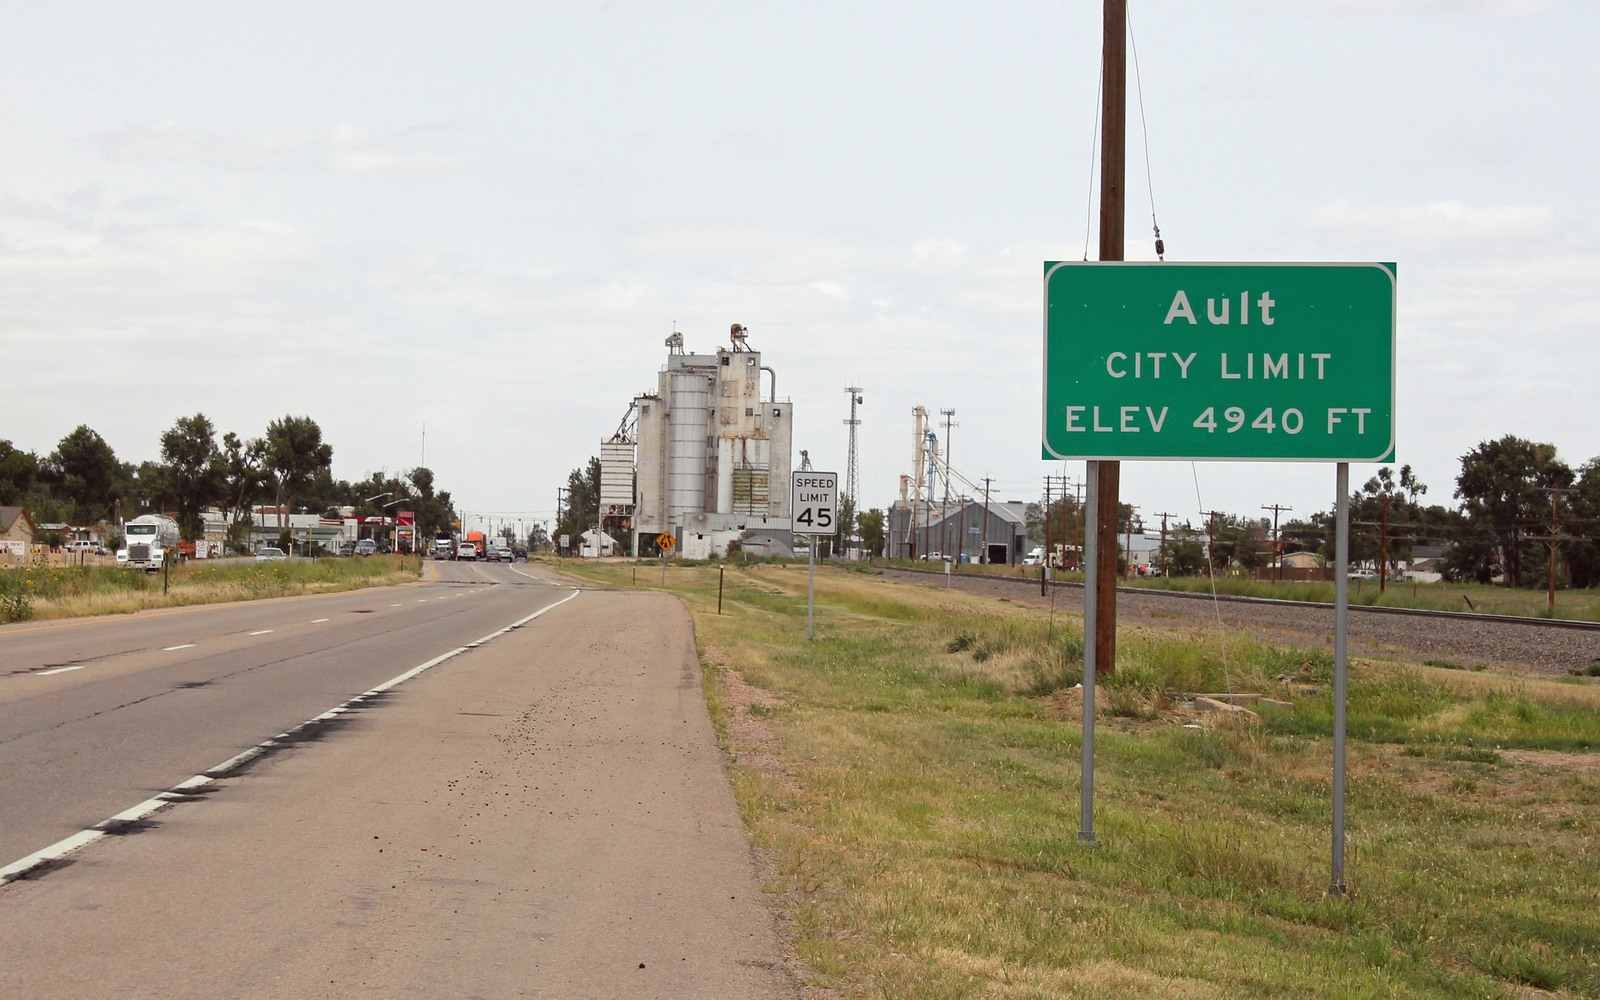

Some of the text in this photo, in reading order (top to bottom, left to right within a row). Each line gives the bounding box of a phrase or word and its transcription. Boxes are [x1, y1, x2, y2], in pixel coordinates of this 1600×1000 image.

[1164, 289, 1275, 325] Ault
[1106, 351, 1331, 379] CITY LIMIT
[1066, 406, 1371, 434] ELEV 4940 FT
[796, 478, 834, 489] SPEED
[800, 493, 829, 502] LIMIT
[796, 507, 832, 527] 45
